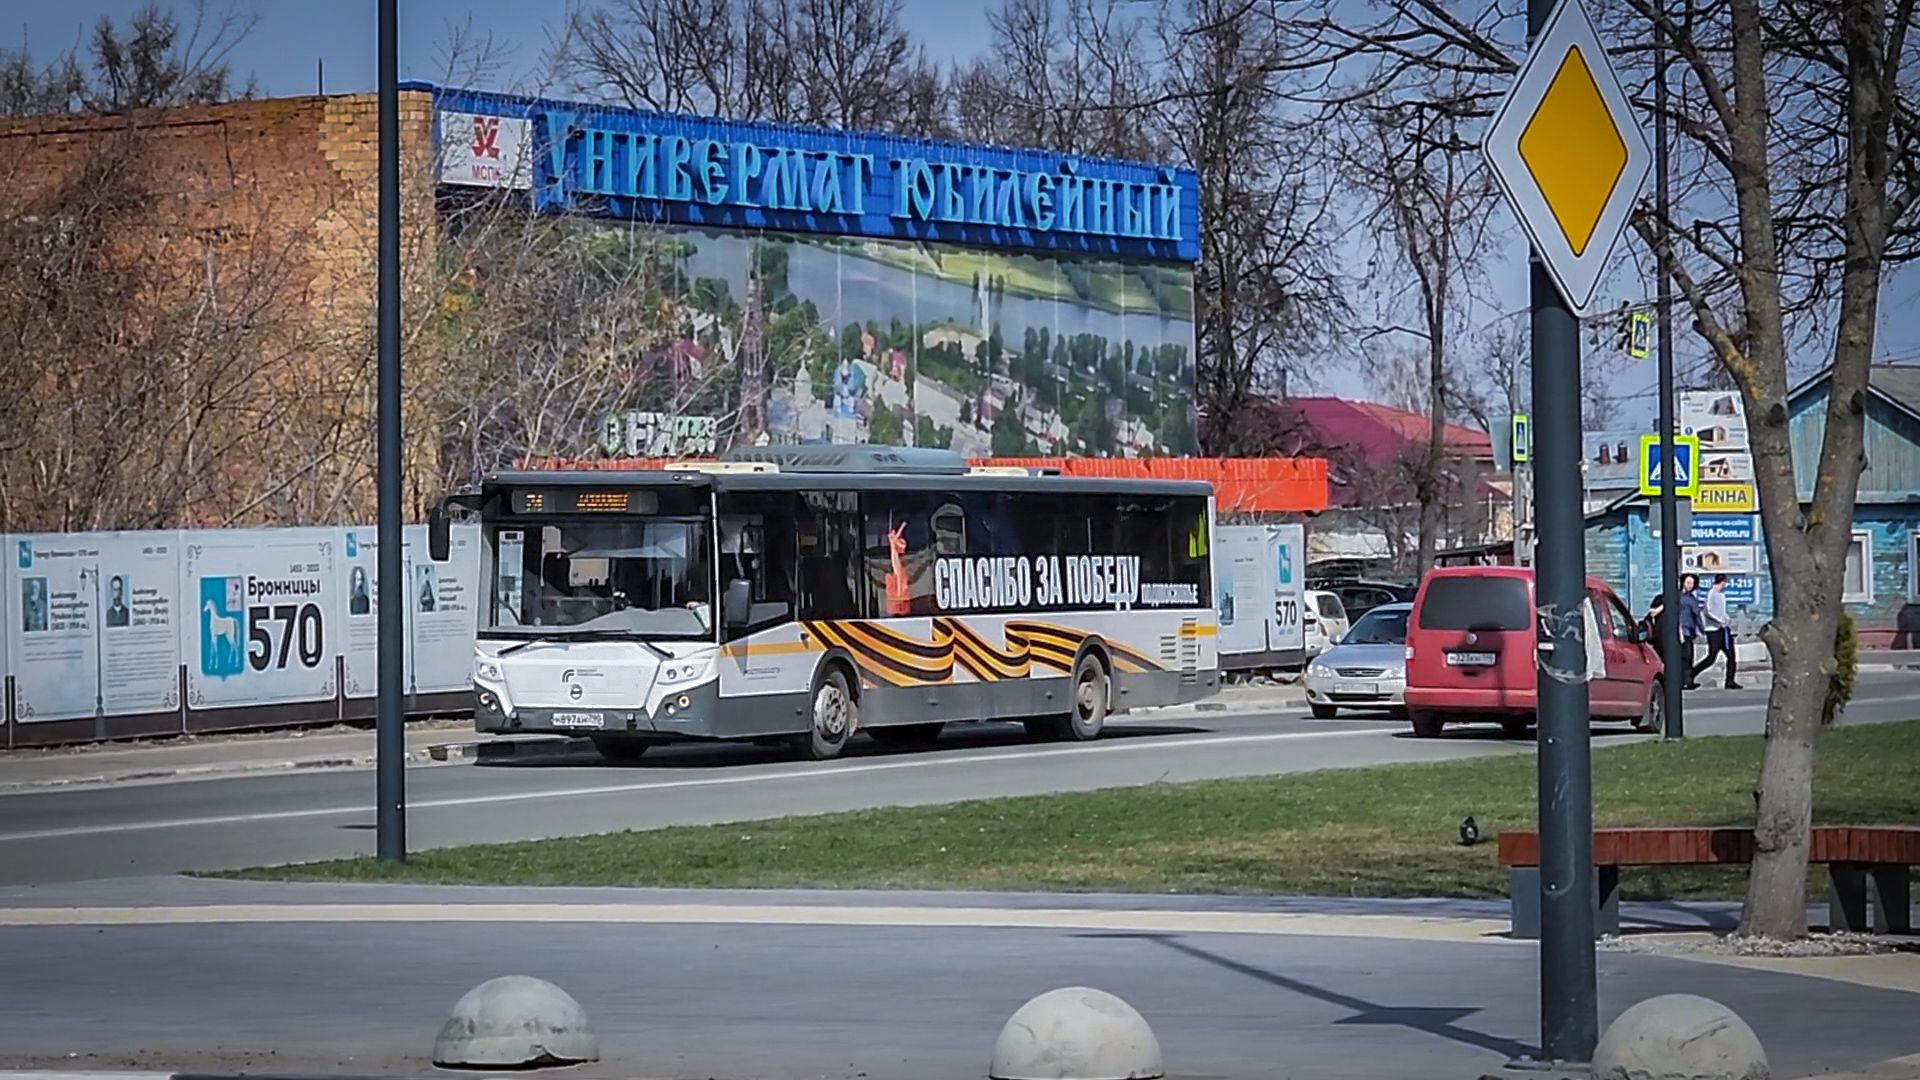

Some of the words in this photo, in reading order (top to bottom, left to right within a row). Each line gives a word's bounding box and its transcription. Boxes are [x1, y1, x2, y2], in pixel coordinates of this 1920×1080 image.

[890, 157, 1184, 241] ЮБИЛЕЙНЫЙ
[1700, 490, 1747, 503] FINHA
[248, 576, 321, 603] Бронницы
[934, 556, 1031, 609] СПАСИБО
[1035, 555, 1063, 606] ЗА
[1066, 554, 1140, 612] ПОБЕДУ
[1275, 600, 1297, 627] 570
[248, 603, 323, 672] 570
